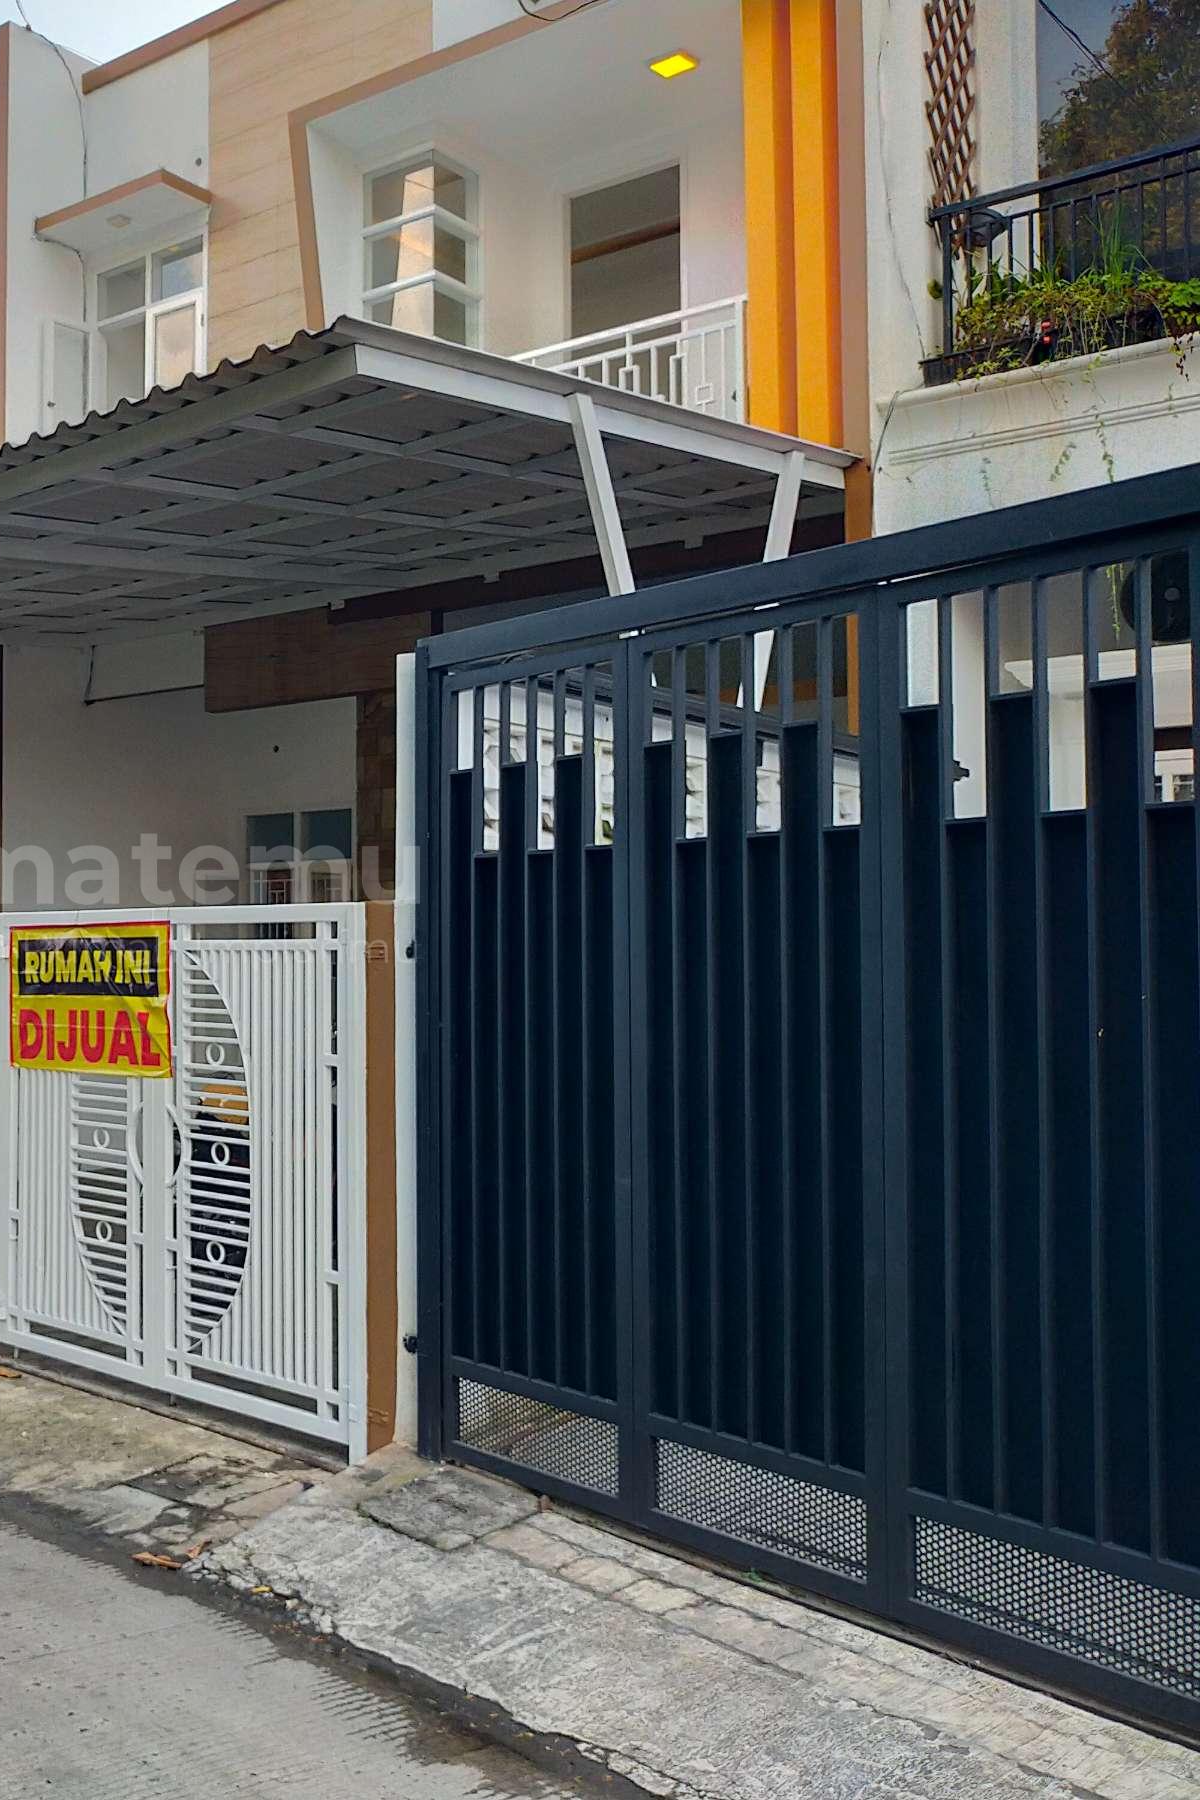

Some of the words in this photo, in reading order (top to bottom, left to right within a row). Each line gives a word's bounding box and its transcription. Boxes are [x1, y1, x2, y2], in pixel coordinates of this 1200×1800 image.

[24, 949, 113, 985] RUMAH
[114, 949, 151, 986] INI
[18, 1008, 161, 1066] DIJUAL
